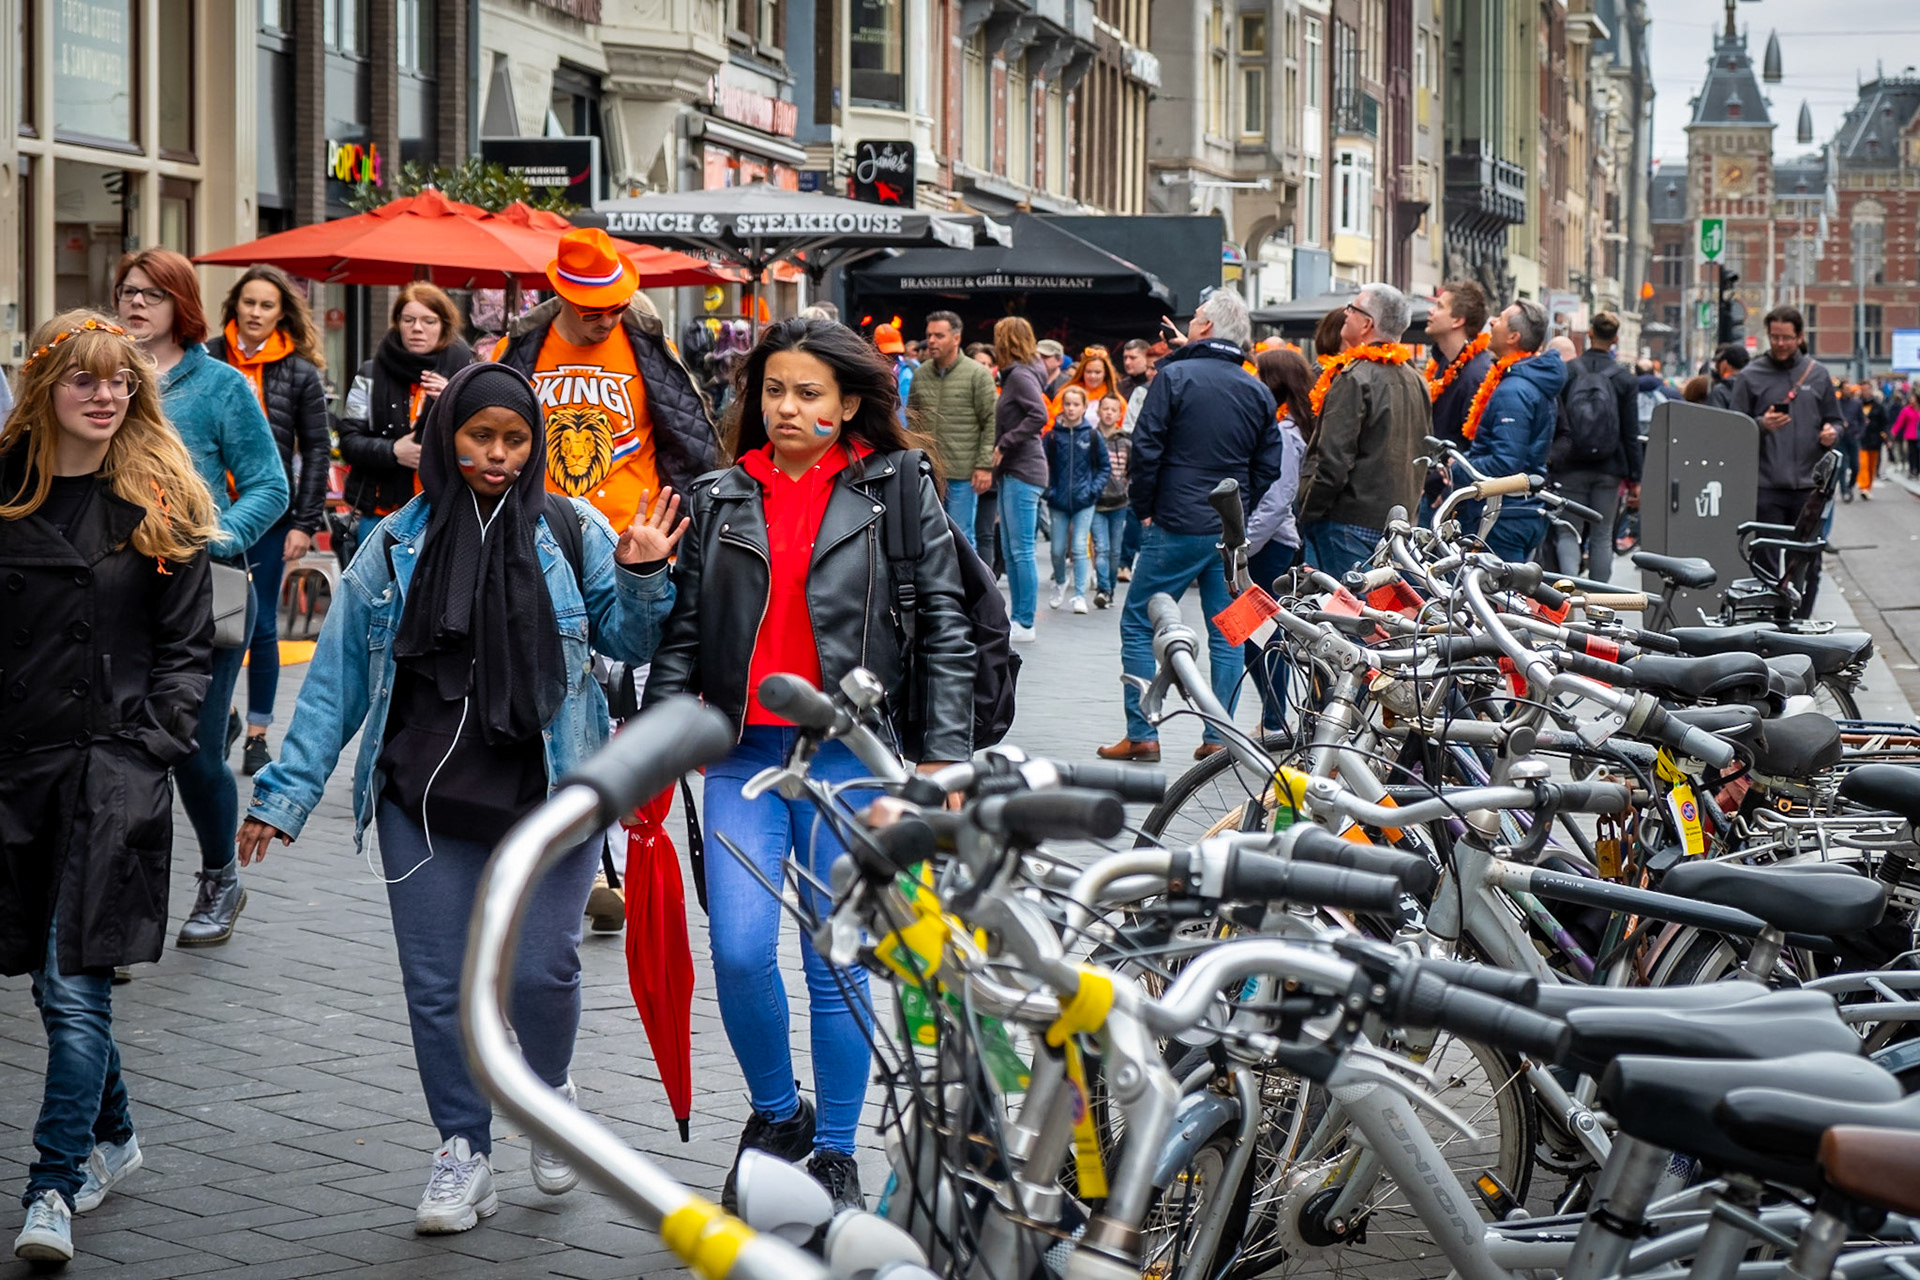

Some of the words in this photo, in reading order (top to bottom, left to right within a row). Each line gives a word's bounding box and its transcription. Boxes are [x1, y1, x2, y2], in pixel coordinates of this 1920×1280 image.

[606, 212, 695, 233] LUNCH
[700, 215, 719, 233] &
[736, 213, 902, 233] STEAKHOUSE
[900, 278, 964, 289] BRASSERIE
[965, 277, 974, 287] &
[976, 275, 1012, 287] GRILL
[1014, 276, 1094, 288] RESTAURANT
[538, 376, 627, 417] KING
